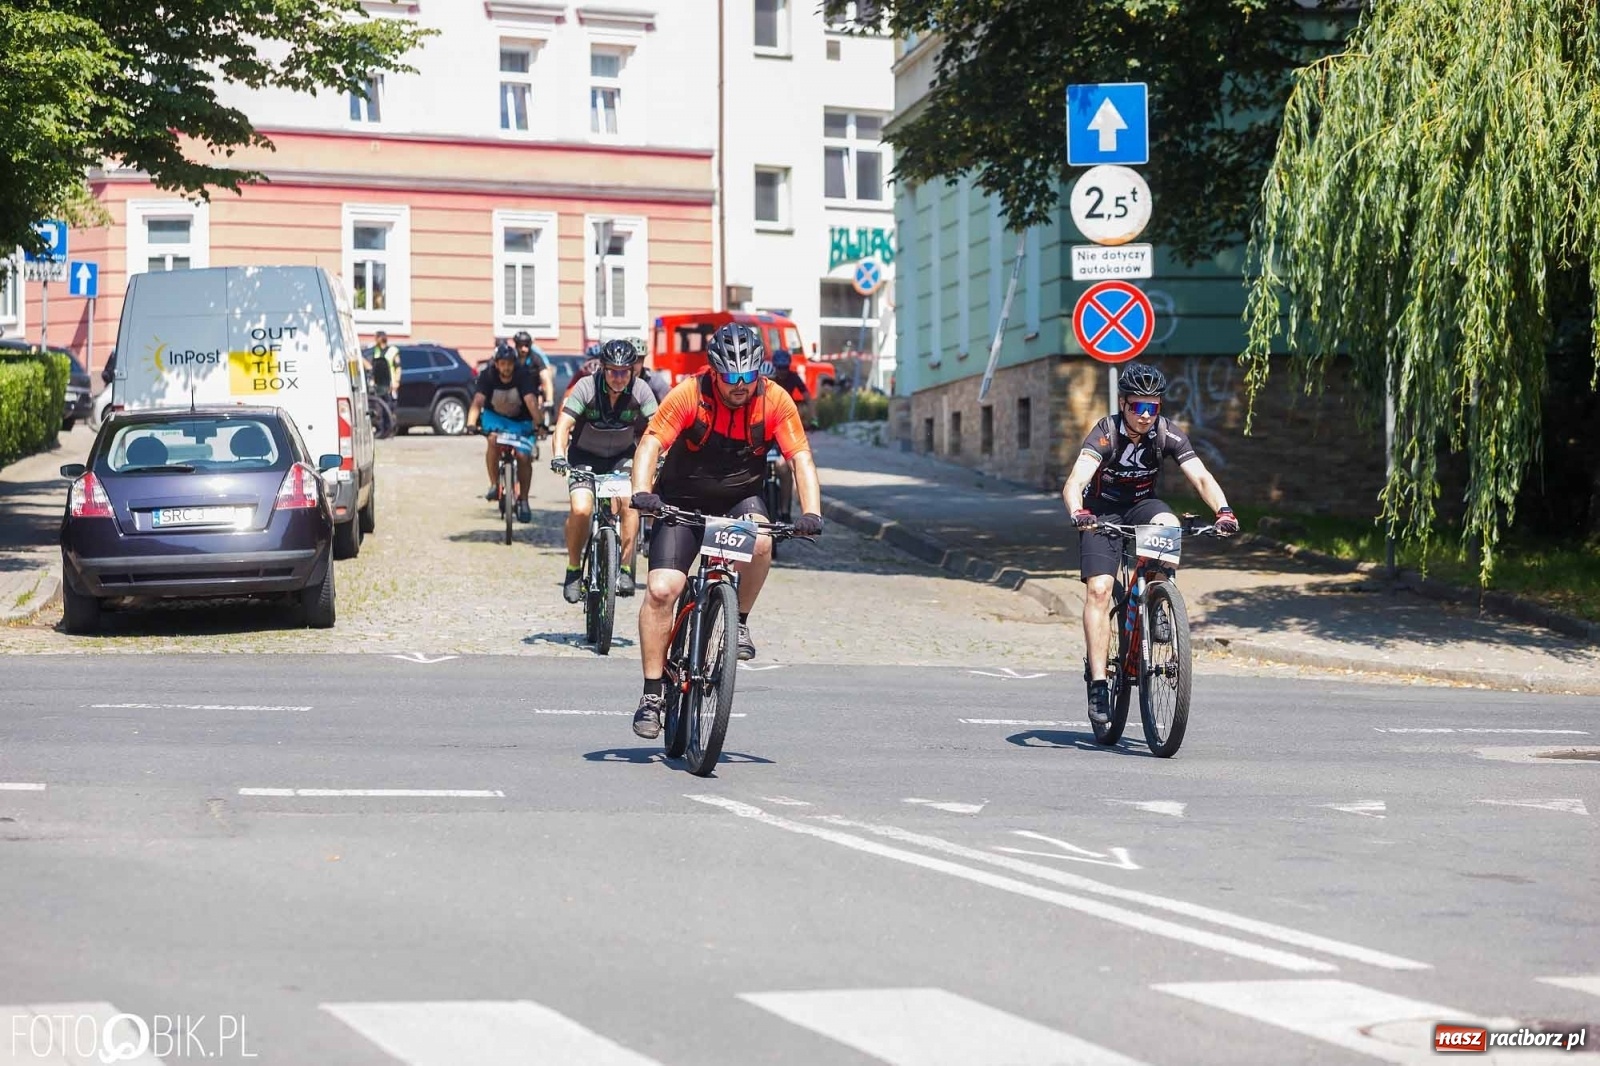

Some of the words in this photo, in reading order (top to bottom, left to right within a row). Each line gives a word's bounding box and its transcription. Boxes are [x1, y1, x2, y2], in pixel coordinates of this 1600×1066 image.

[1077, 251, 1097, 260] Nie
[1101, 250, 1146, 261] dotyczy
[1079, 264, 1141, 274] autokarów
[251, 327, 297, 340] OUT
[169, 349, 220, 365] InPost
[251, 344, 282, 357] OF
[252, 360, 297, 373] THE
[253, 377, 299, 390] BOX
[162, 508, 192, 522] SRC
[714, 531, 747, 548] 1367
[1144, 535, 1174, 550] 2053
